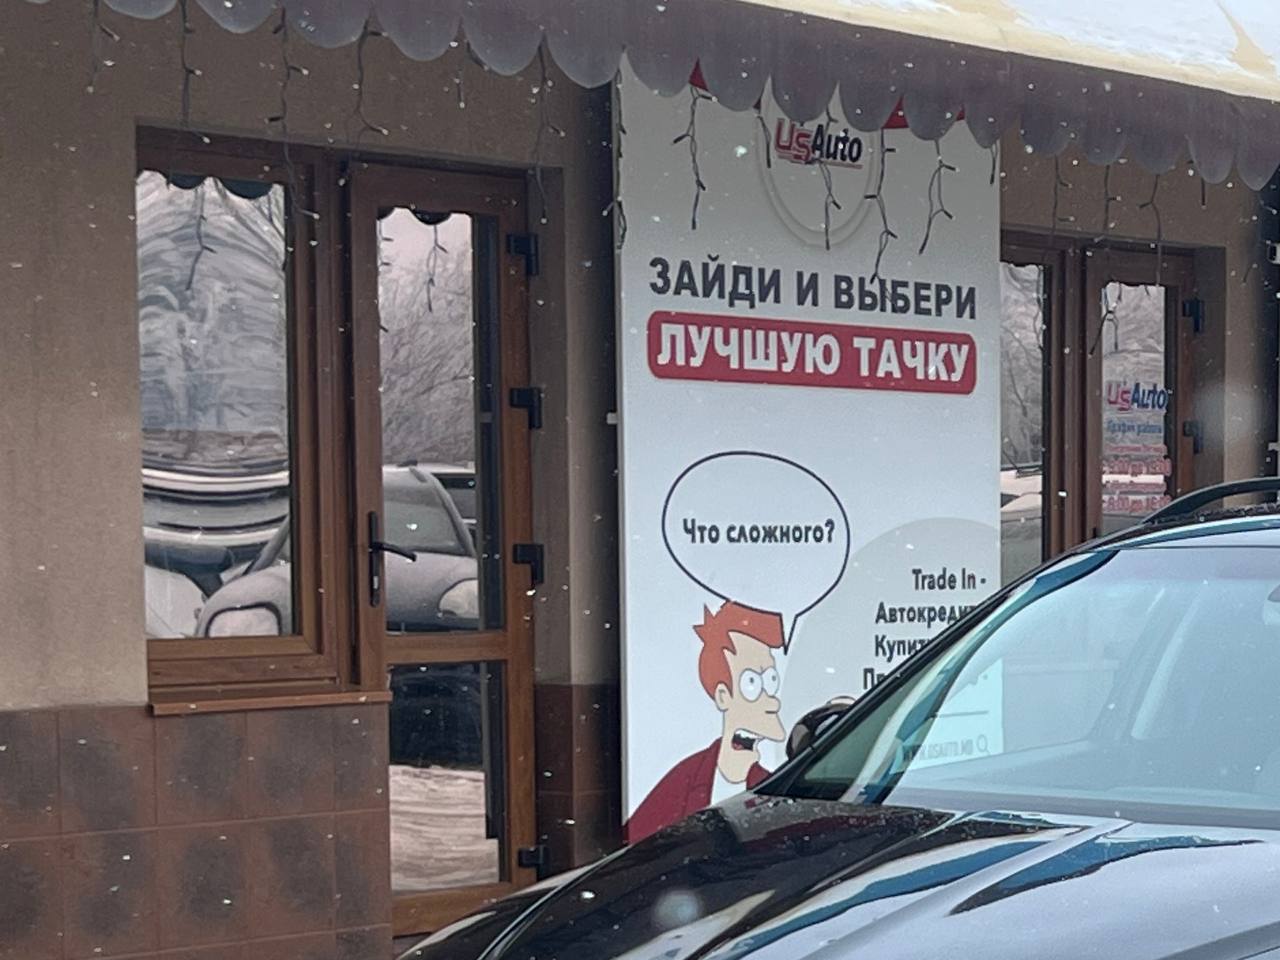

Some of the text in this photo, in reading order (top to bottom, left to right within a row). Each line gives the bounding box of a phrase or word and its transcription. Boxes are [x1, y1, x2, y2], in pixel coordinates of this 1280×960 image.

[649, 254, 977, 320] ЗАЙДИ И ВЫБЕРИ
[657, 322, 969, 383] ЛУЧШУЮ ТАЧКУ
[683, 518, 835, 545] Что сложного?
[912, 566, 957, 591] Trade
[961, 567, 976, 590] In
